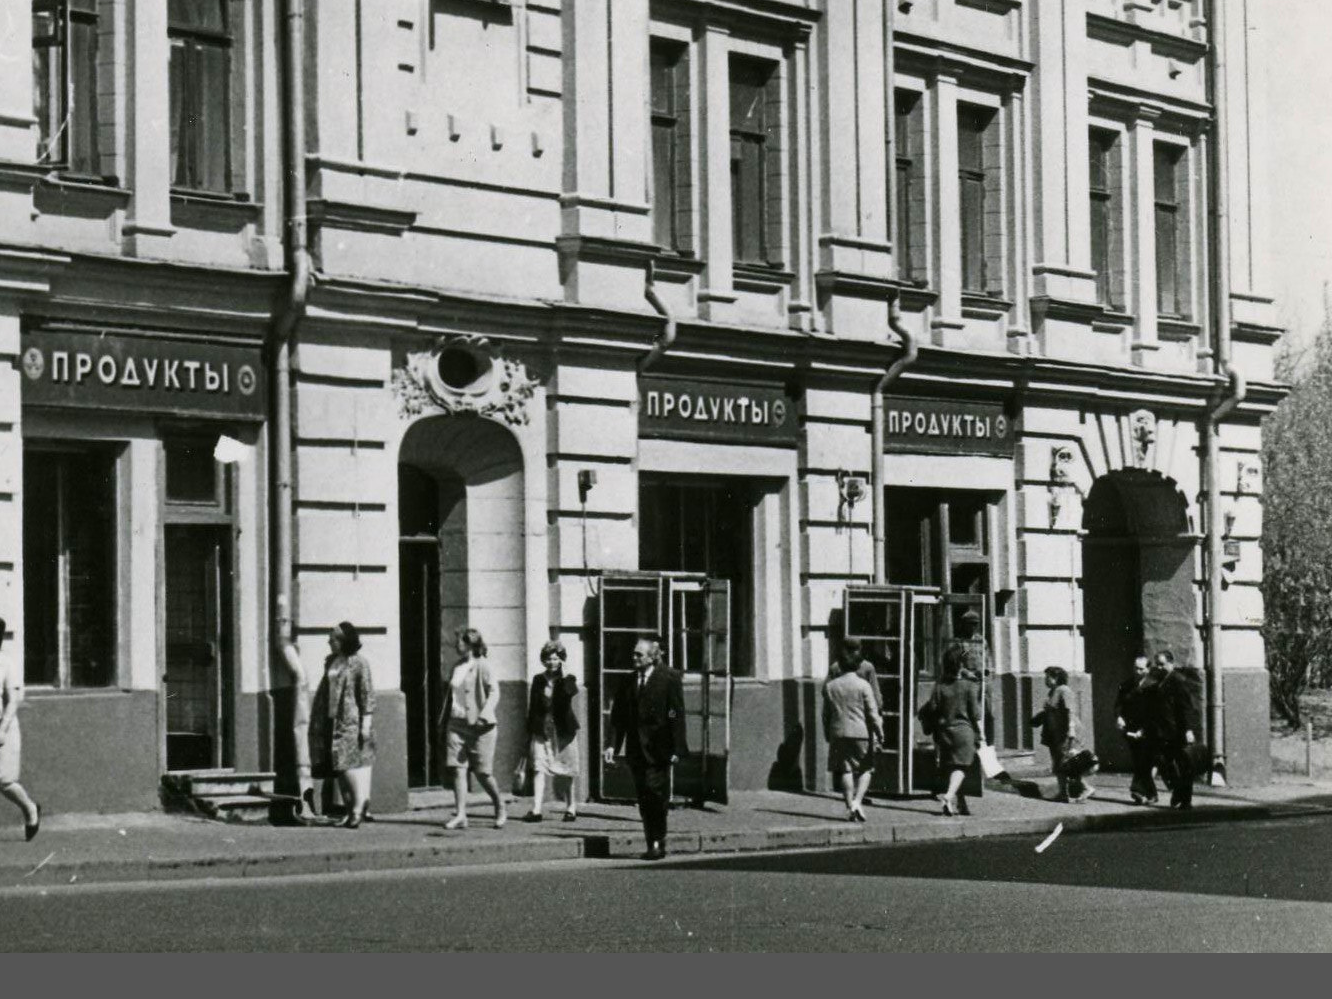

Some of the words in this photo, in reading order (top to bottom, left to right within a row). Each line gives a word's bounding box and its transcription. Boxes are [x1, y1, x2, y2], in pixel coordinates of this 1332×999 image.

[52, 351, 229, 392] ПРОДУКТЫ
[647, 390, 769, 424] ПРОДУКТЫ
[889, 410, 990, 438] ПРОДУКТЫ
